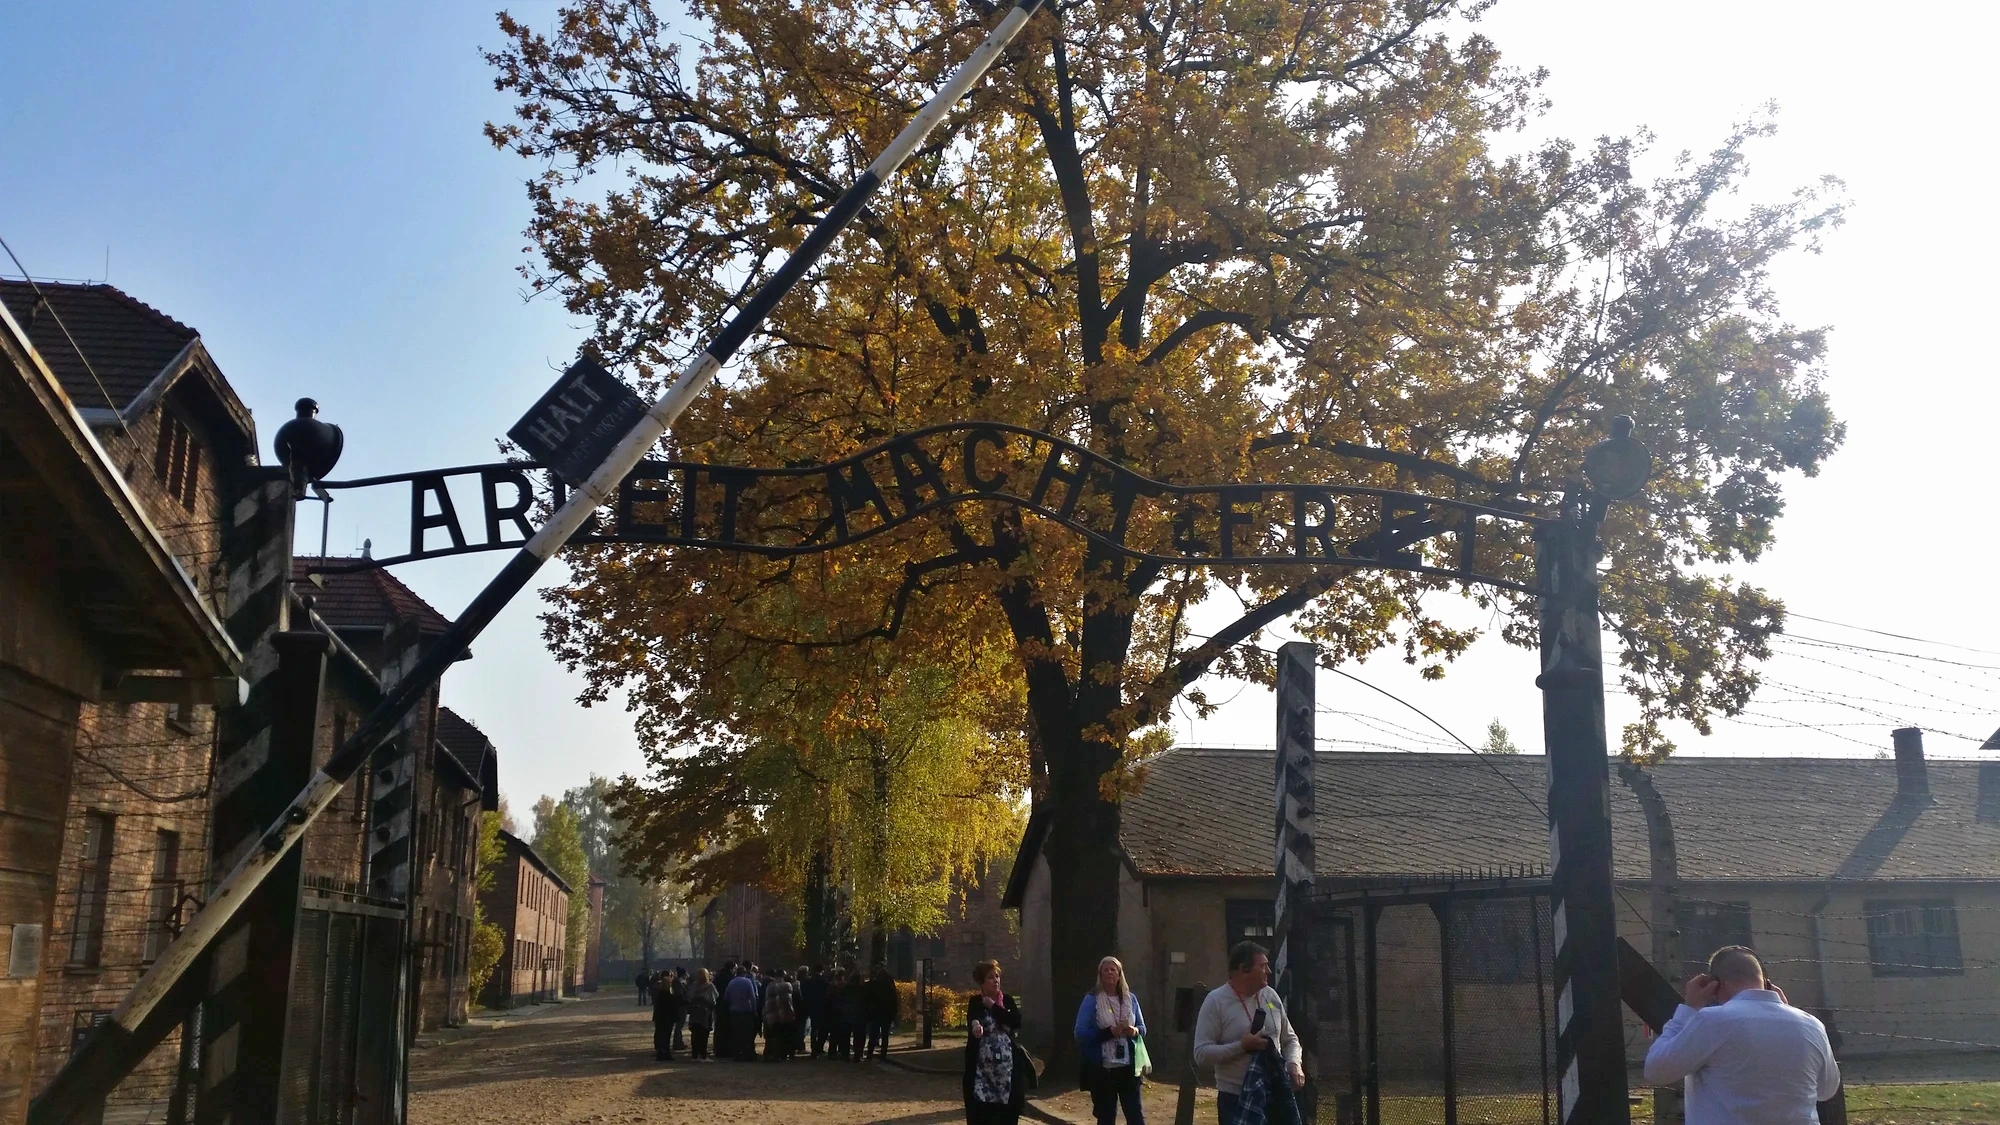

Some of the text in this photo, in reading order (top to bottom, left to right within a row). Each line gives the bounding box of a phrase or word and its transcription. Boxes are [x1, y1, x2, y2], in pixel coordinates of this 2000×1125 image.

[527, 374, 603, 450] HALT
[825, 428, 1163, 545] MACHT
[1219, 488, 1476, 572] FREI
